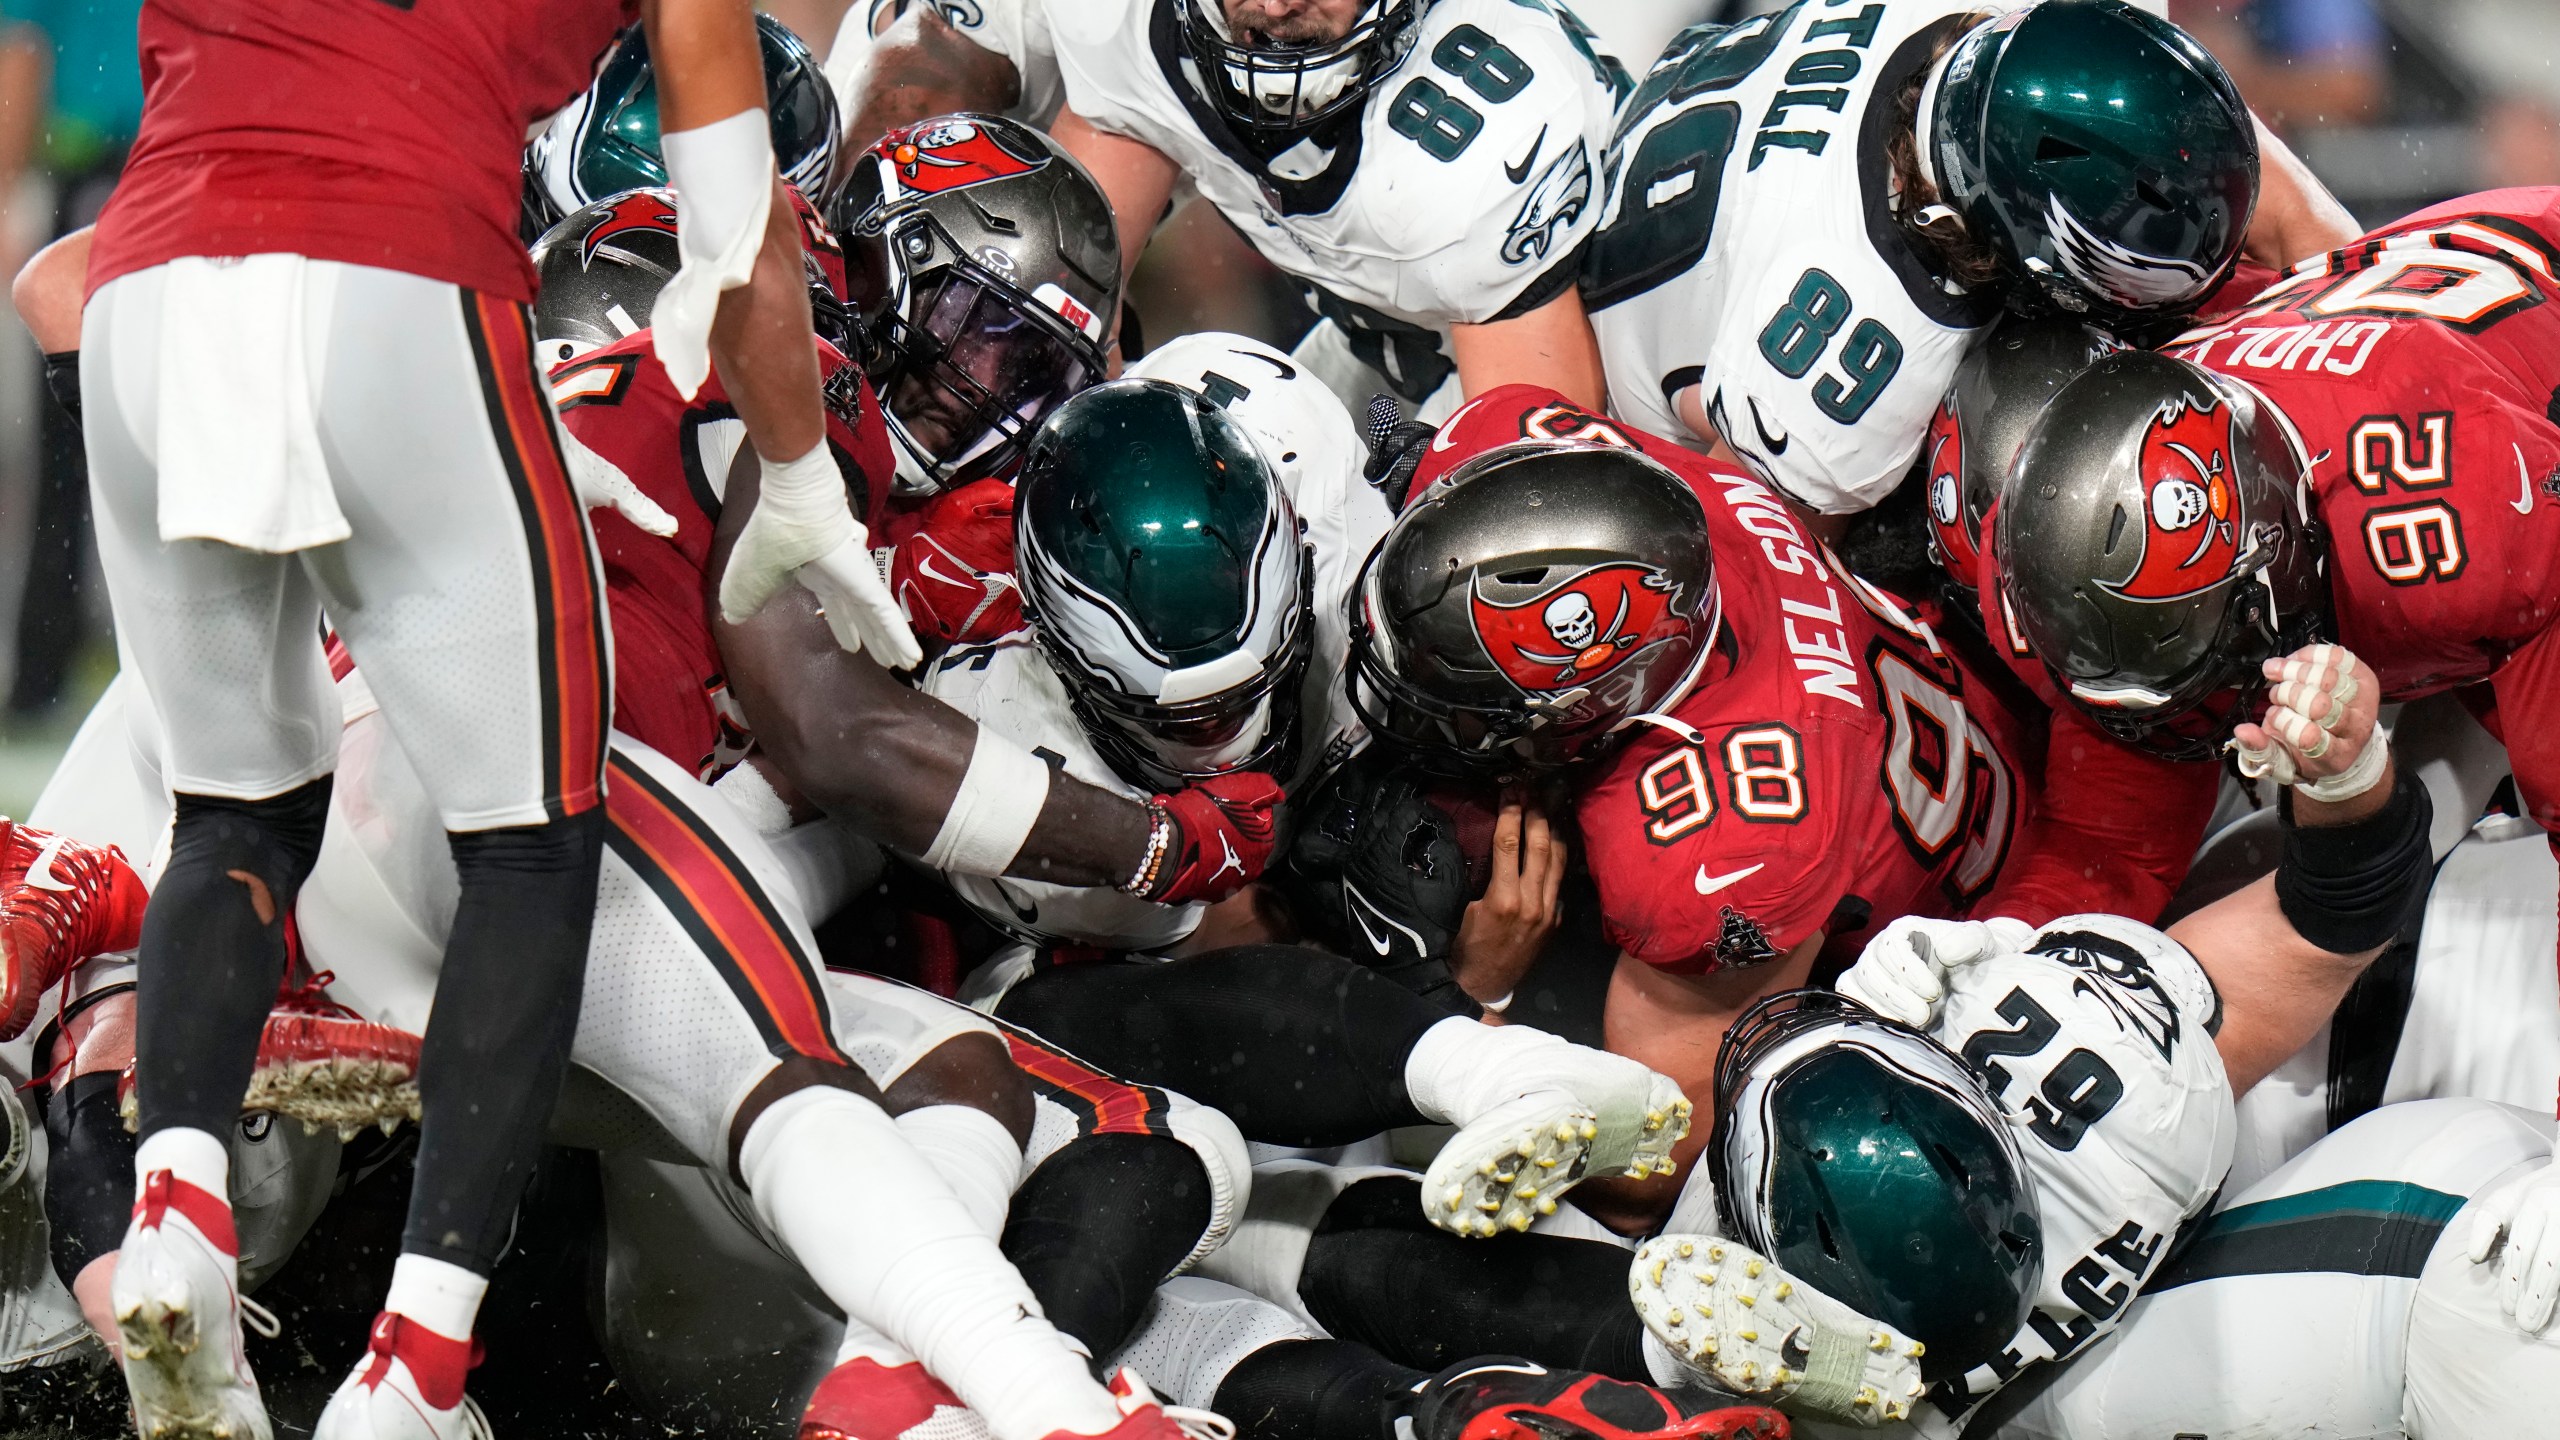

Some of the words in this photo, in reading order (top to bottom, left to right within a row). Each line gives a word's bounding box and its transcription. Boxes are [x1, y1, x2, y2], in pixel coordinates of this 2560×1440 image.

[1388, 24, 1534, 163] 88
[1747, 0, 1886, 173] TOLL
[972, 252, 1018, 283] OAKLEY
[1758, 267, 1903, 425] 89
[2346, 410, 2470, 588] 92
[1709, 472, 1864, 708] NELSON
[1635, 720, 1810, 849] 98
[1961, 984, 2124, 1152] 62
